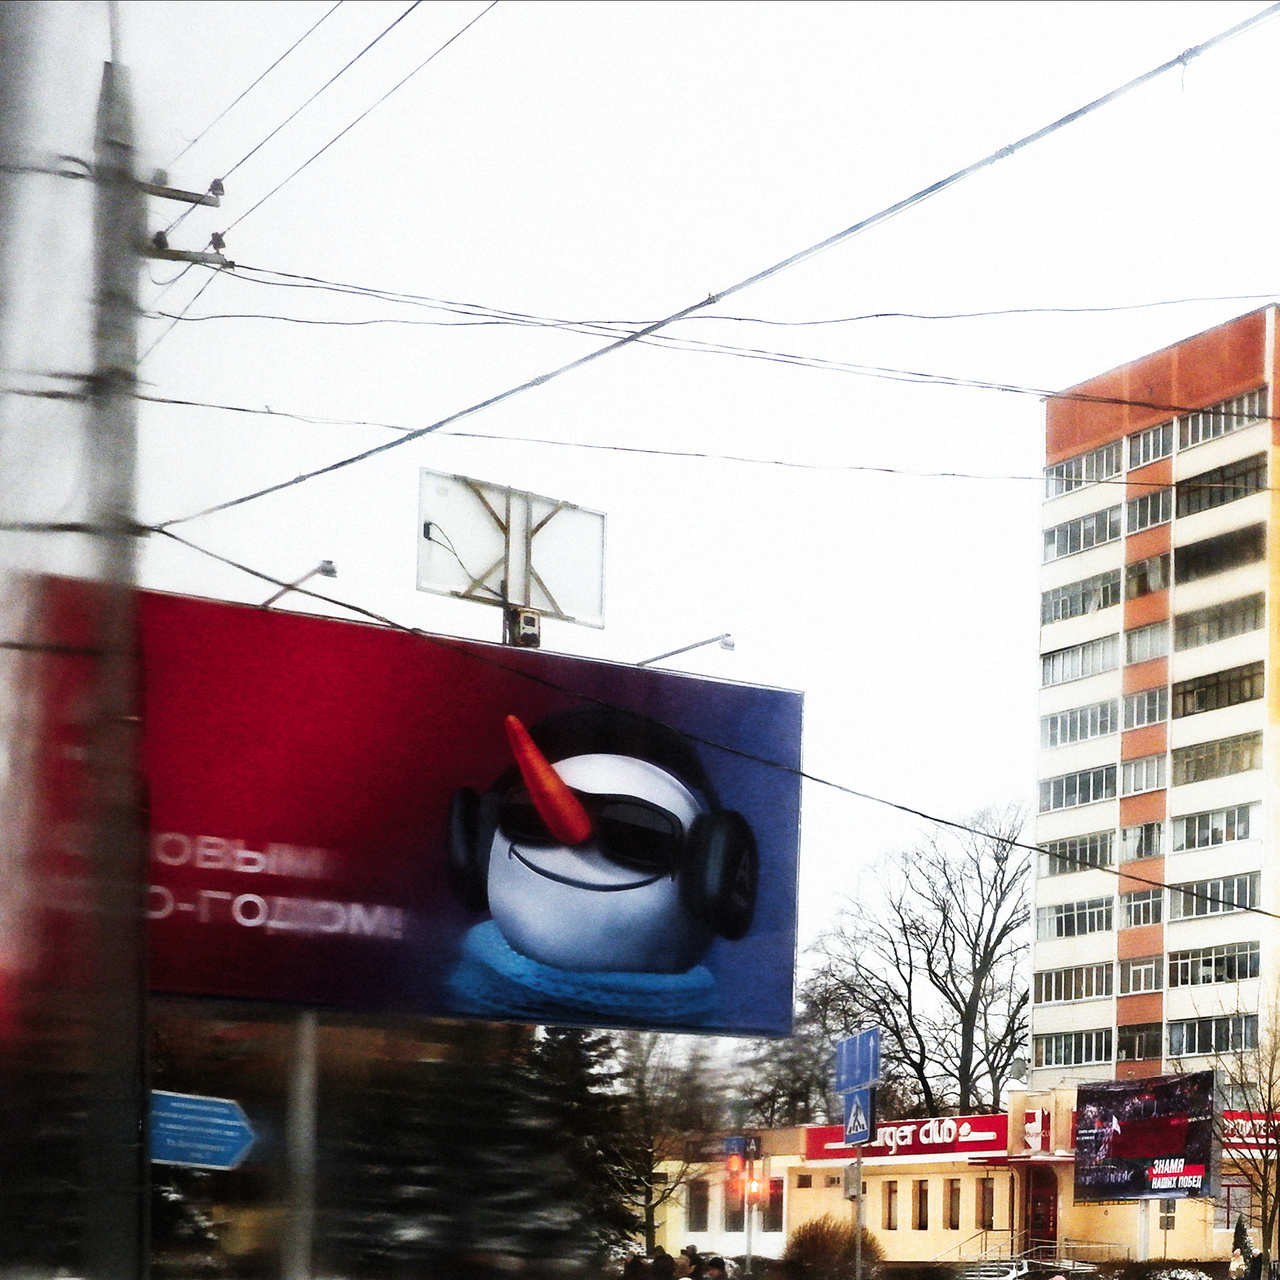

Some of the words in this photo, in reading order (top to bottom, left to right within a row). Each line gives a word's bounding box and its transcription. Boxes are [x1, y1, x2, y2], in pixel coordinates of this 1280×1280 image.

[919, 1117, 957, 1145] club
[1152, 1158, 1185, 1174] ЗНАМЯ
[1151, 1176, 1178, 1189] НАШИХ
[1178, 1175, 1202, 1189] ПОБЕД
